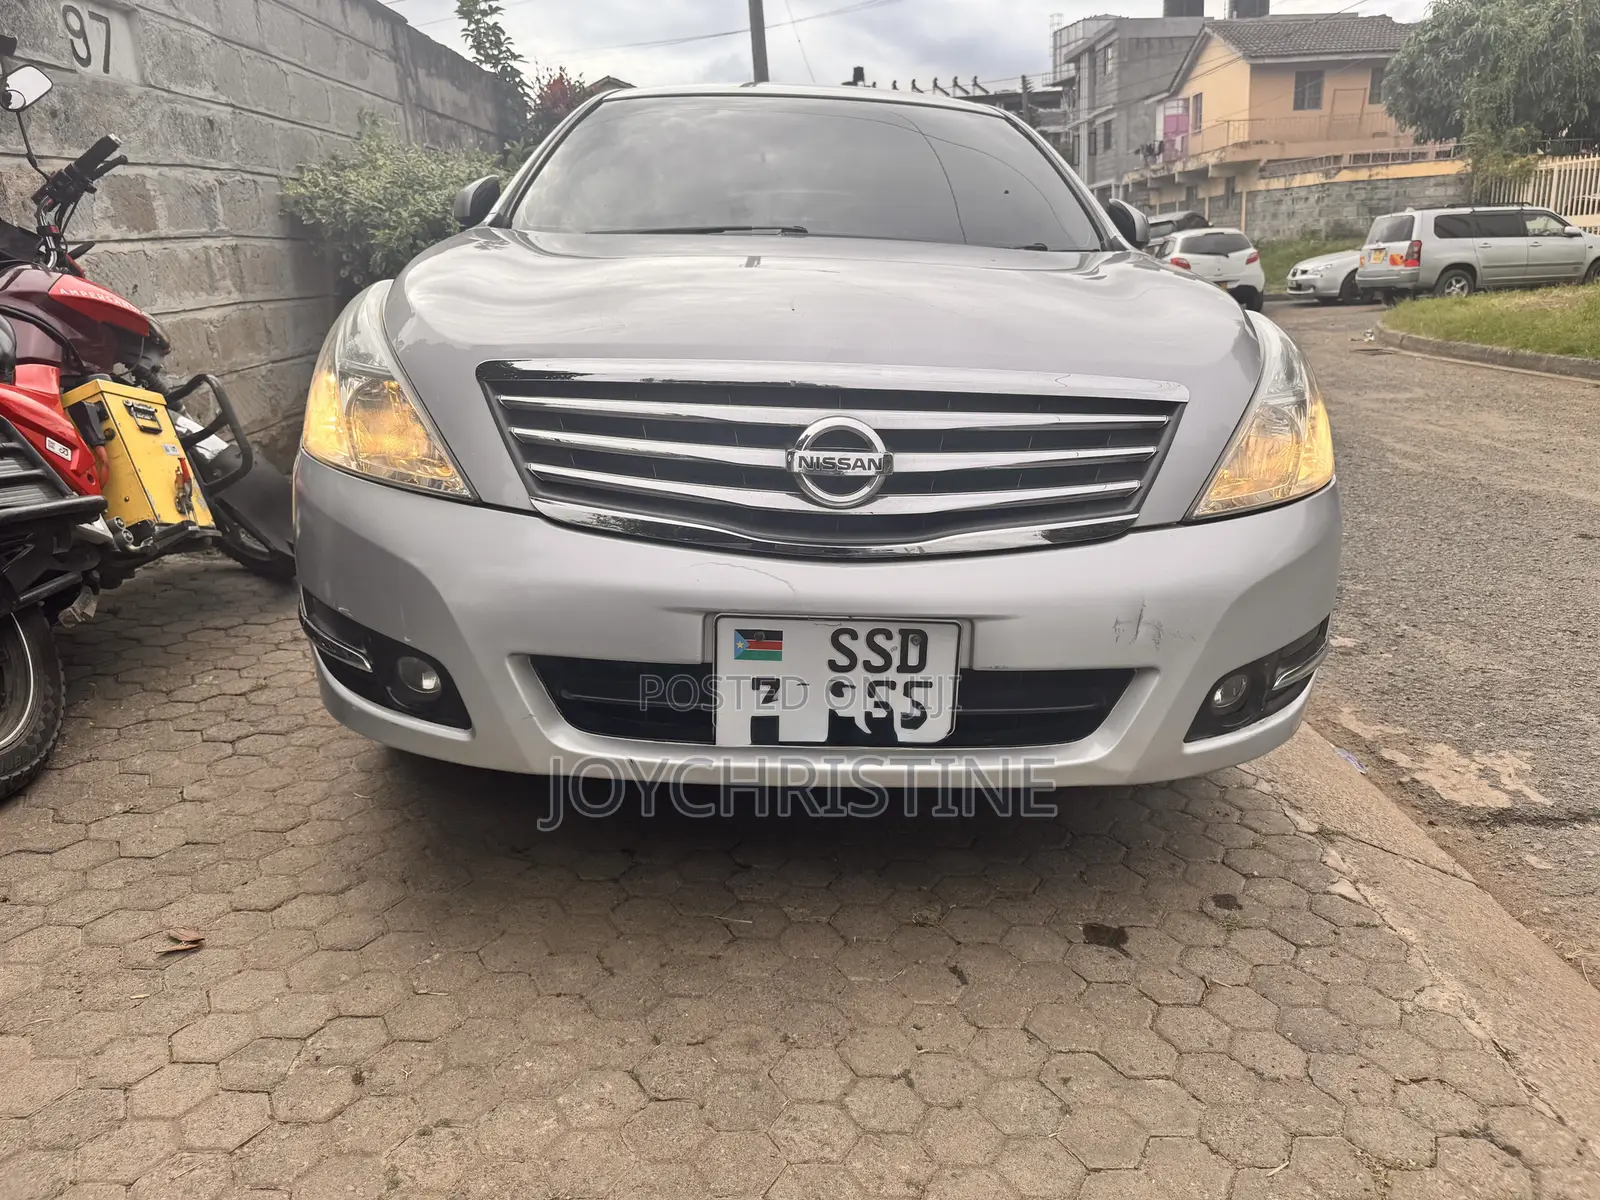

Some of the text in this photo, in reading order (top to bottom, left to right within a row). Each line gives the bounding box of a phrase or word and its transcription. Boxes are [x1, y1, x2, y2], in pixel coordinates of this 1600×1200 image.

[62, 4, 111, 74] 97
[798, 455, 882, 471] NISSAN
[827, 627, 929, 674] SSD
